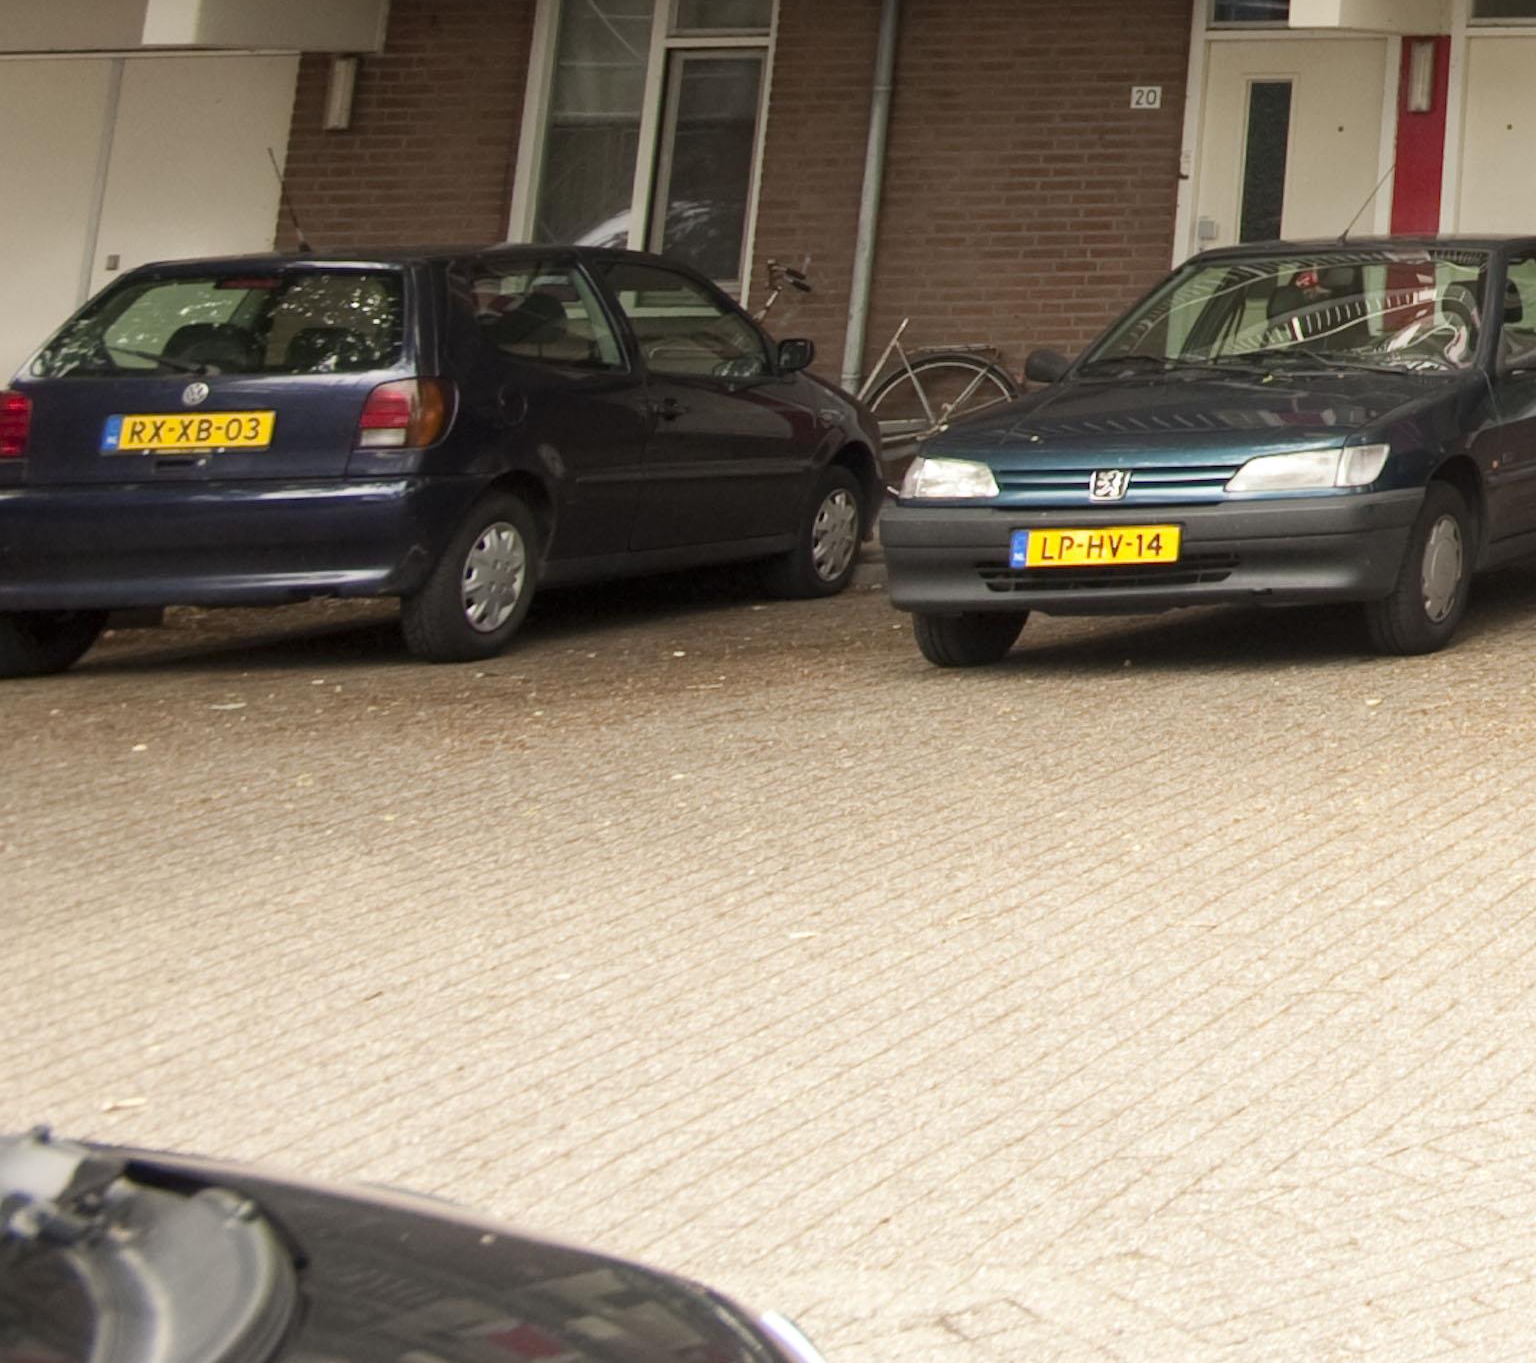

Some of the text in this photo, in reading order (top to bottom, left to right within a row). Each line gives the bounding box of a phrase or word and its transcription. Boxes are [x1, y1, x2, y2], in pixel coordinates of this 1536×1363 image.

[1134, 88, 1158, 106] 20
[128, 417, 261, 444] RX-XB-03
[1040, 532, 1163, 561] LP-HV-14
